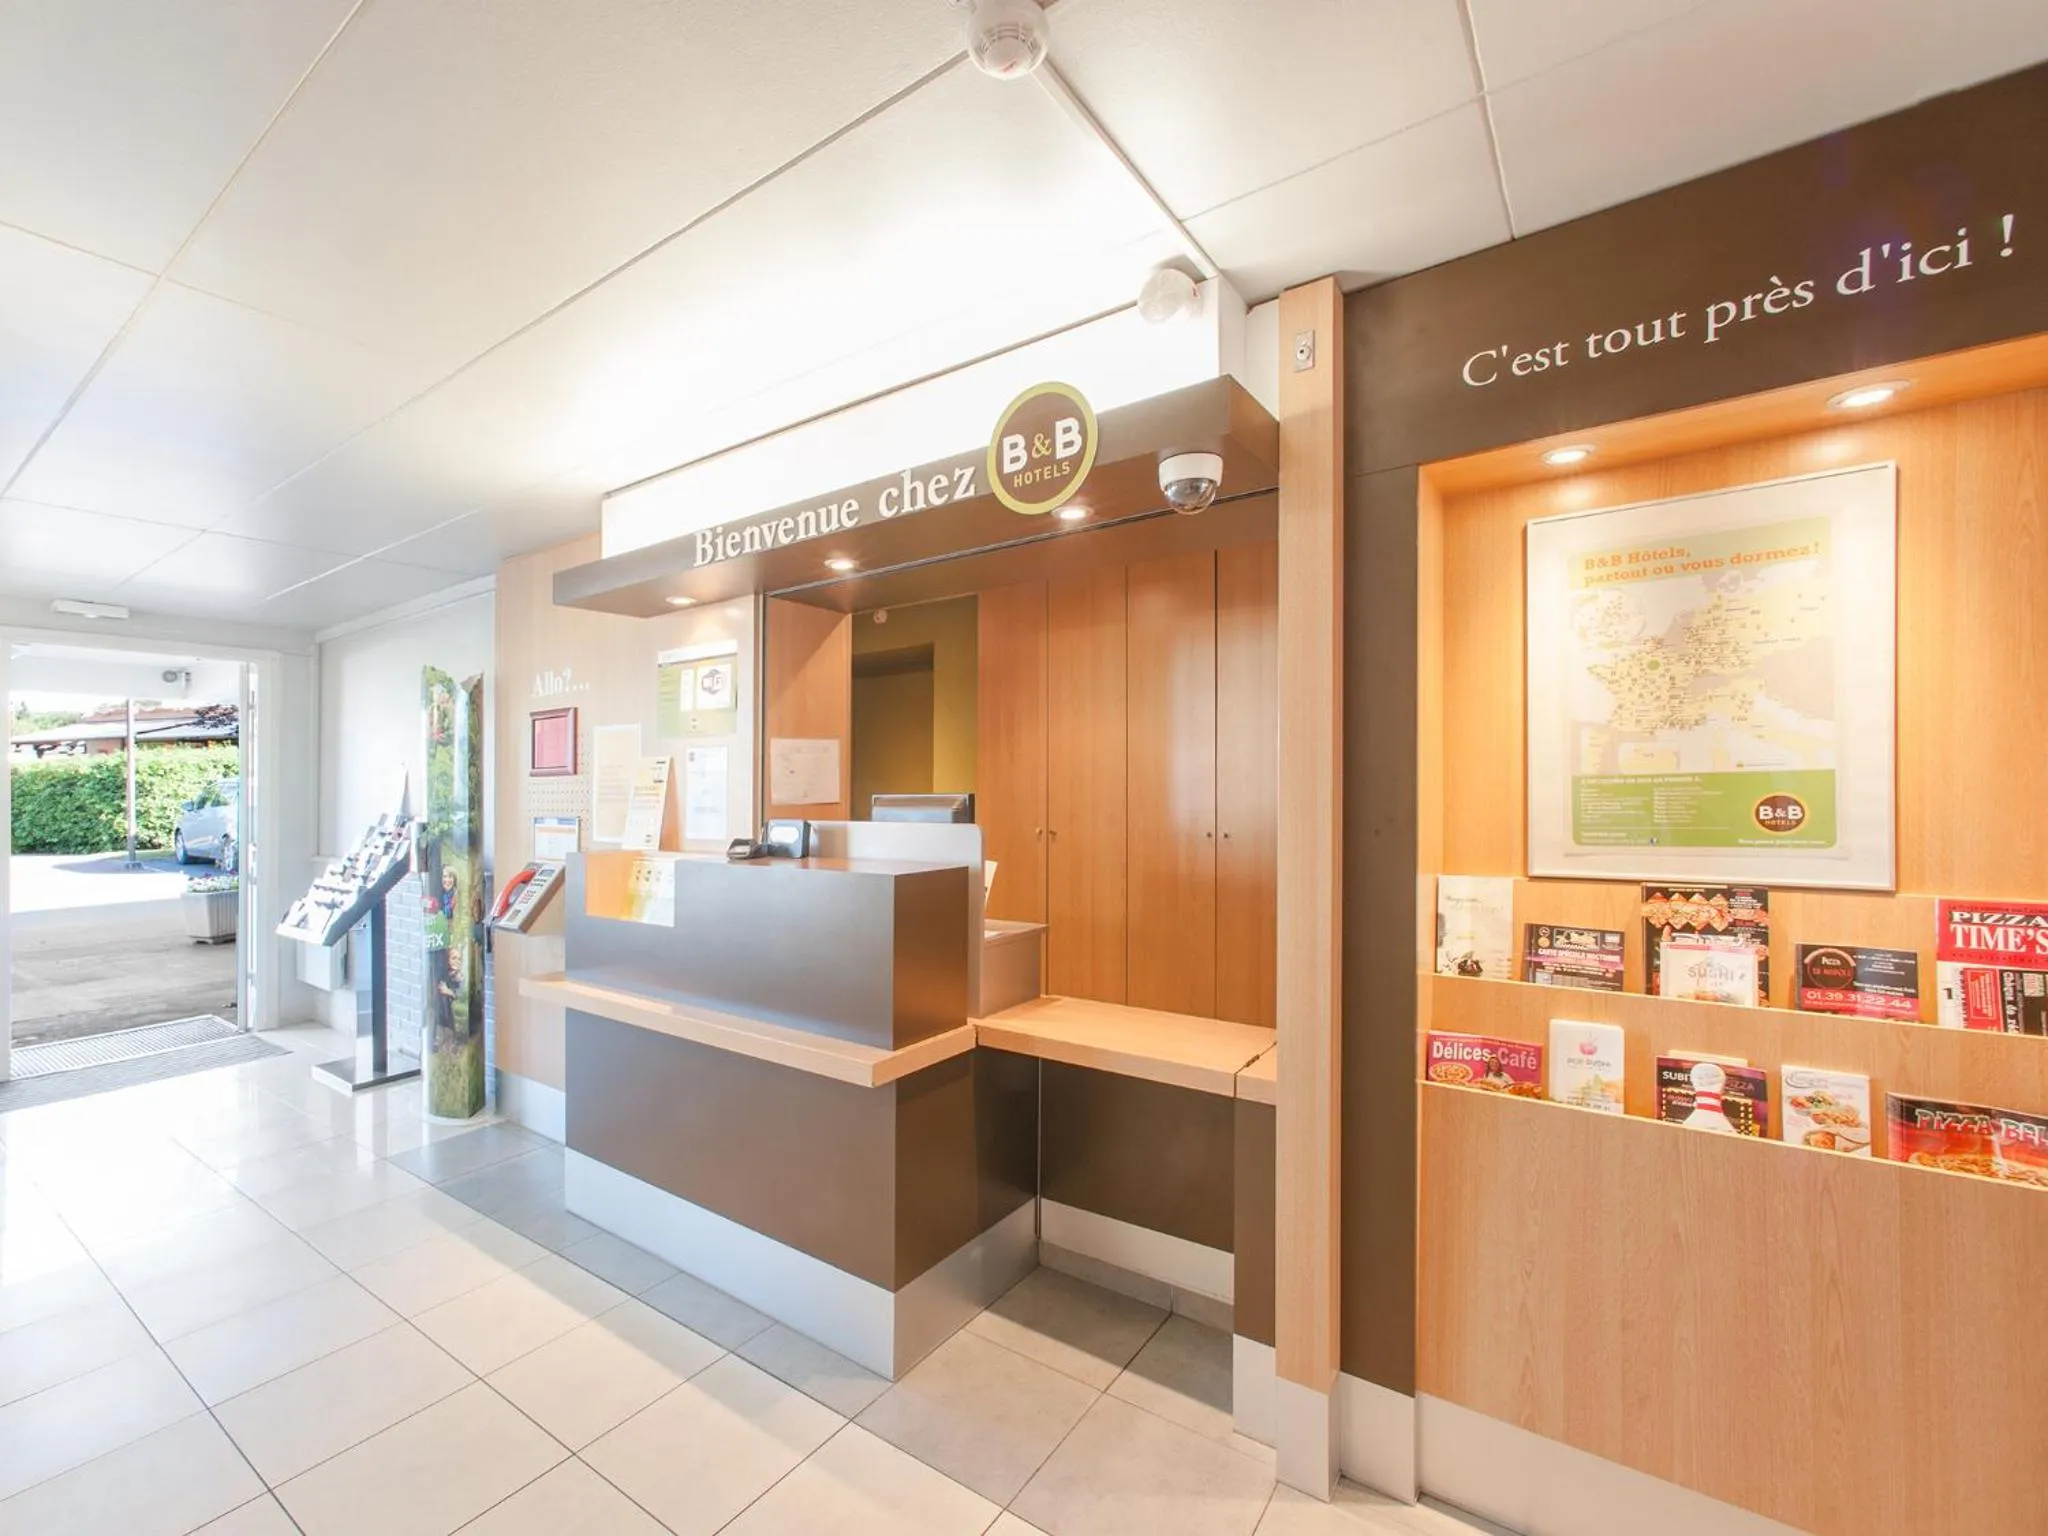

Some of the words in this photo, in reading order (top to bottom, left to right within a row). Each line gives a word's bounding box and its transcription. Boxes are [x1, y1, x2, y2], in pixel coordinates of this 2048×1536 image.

[1462, 342, 1569, 387] C'est
[1585, 311, 1687, 358] tout
[1703, 276, 1815, 343] près
[1836, 226, 1973, 295] d'ici
[1999, 213, 2015, 257] !
[1013, 461, 1071, 488] HOTELS
[693, 497, 860, 567] Bienvenue
[878, 464, 977, 519] chez
[1680, 555, 1725, 572] vous
[1951, 911, 2048, 928] PIZZA
